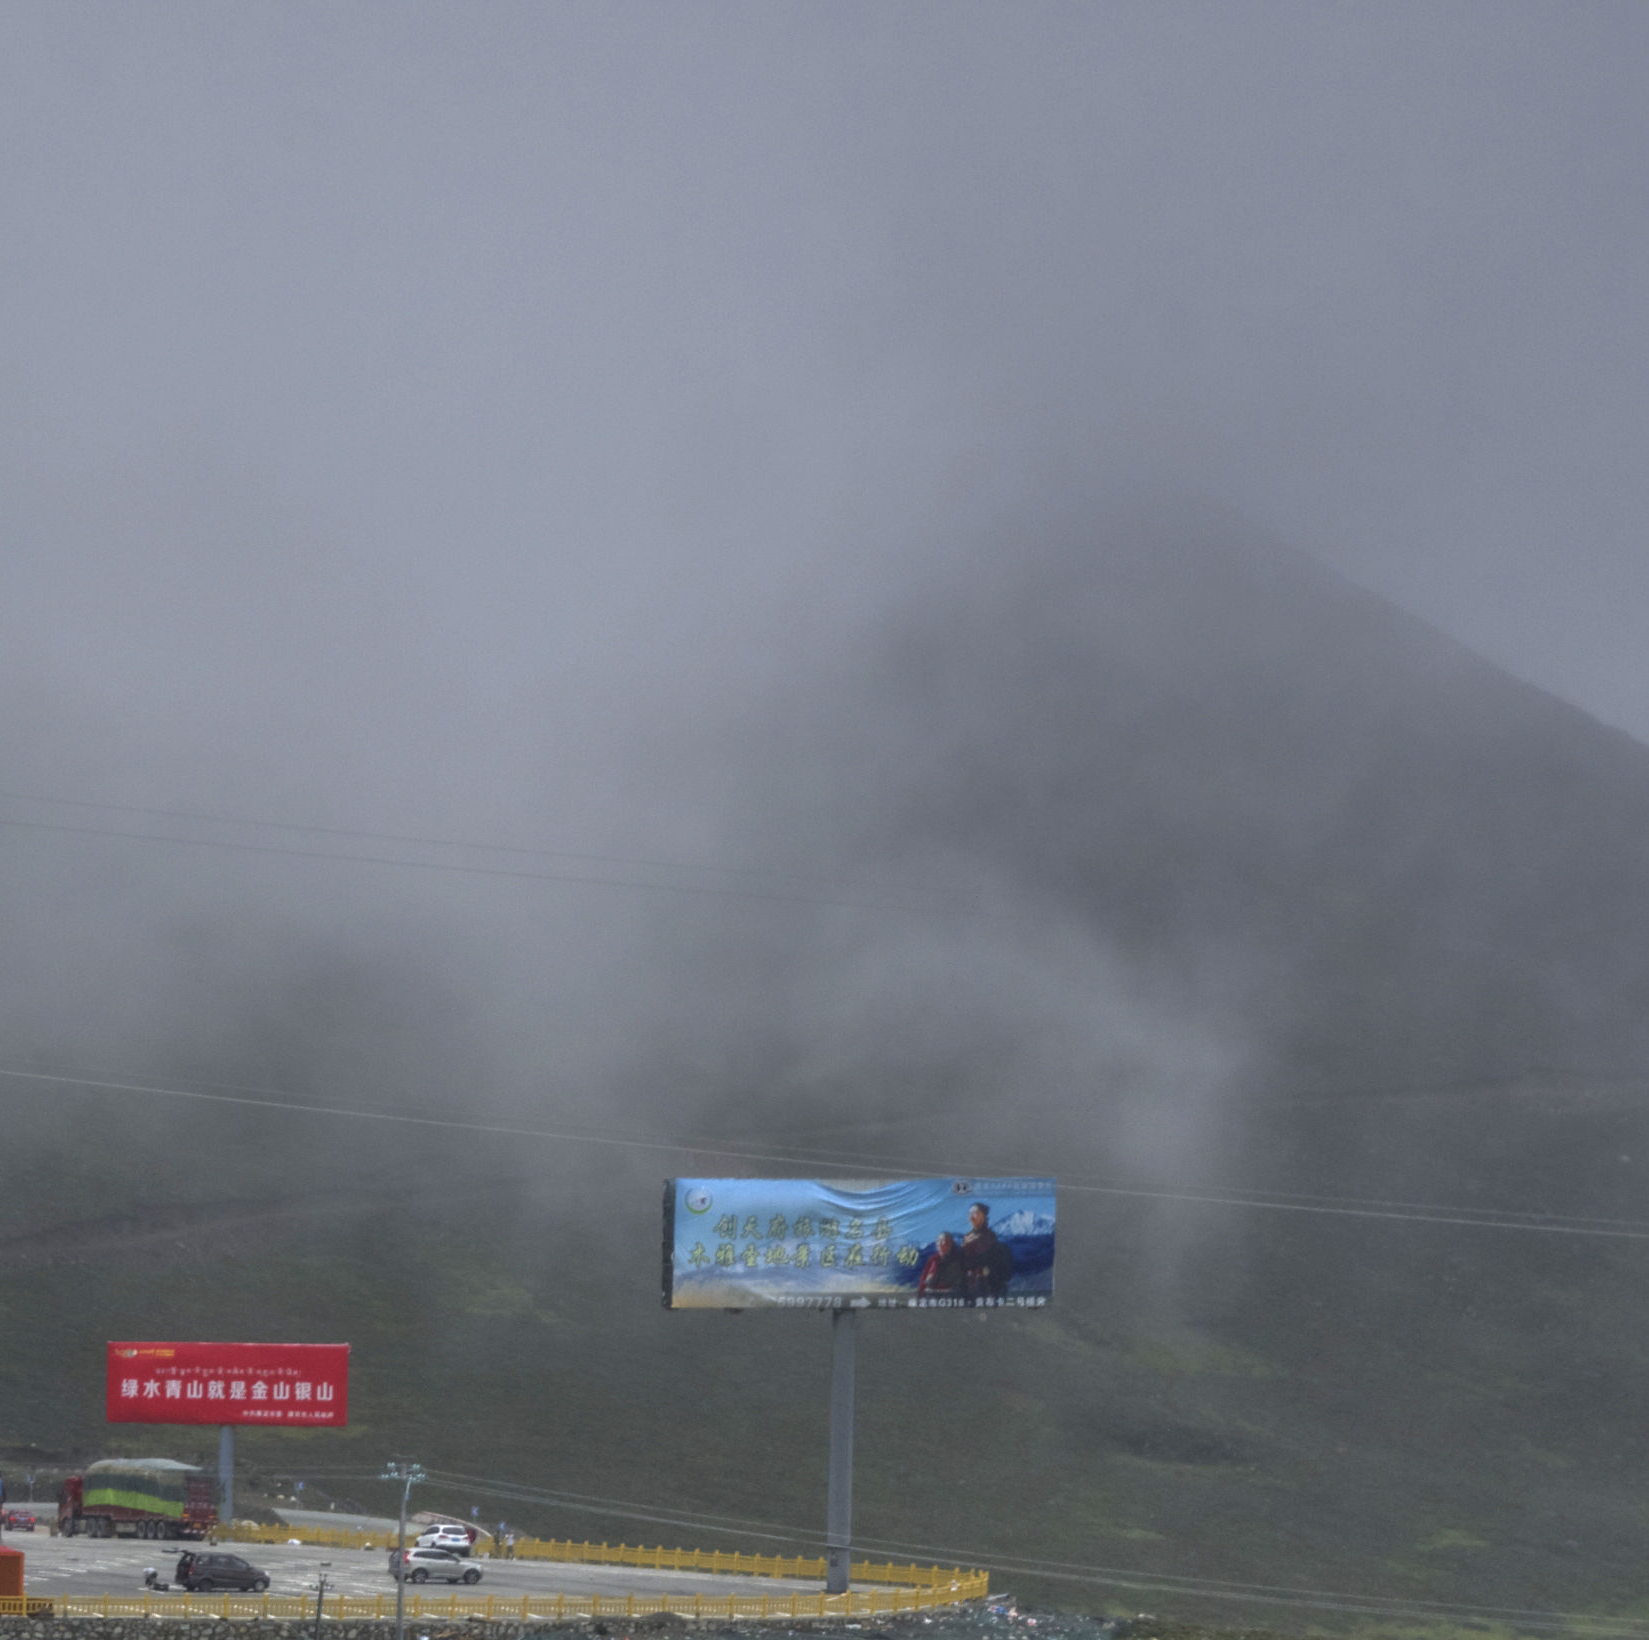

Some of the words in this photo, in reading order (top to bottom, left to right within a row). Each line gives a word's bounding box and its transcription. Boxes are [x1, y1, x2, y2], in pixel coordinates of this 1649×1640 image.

[121, 1378, 334, 1401] 绿水青山就是金山银山
